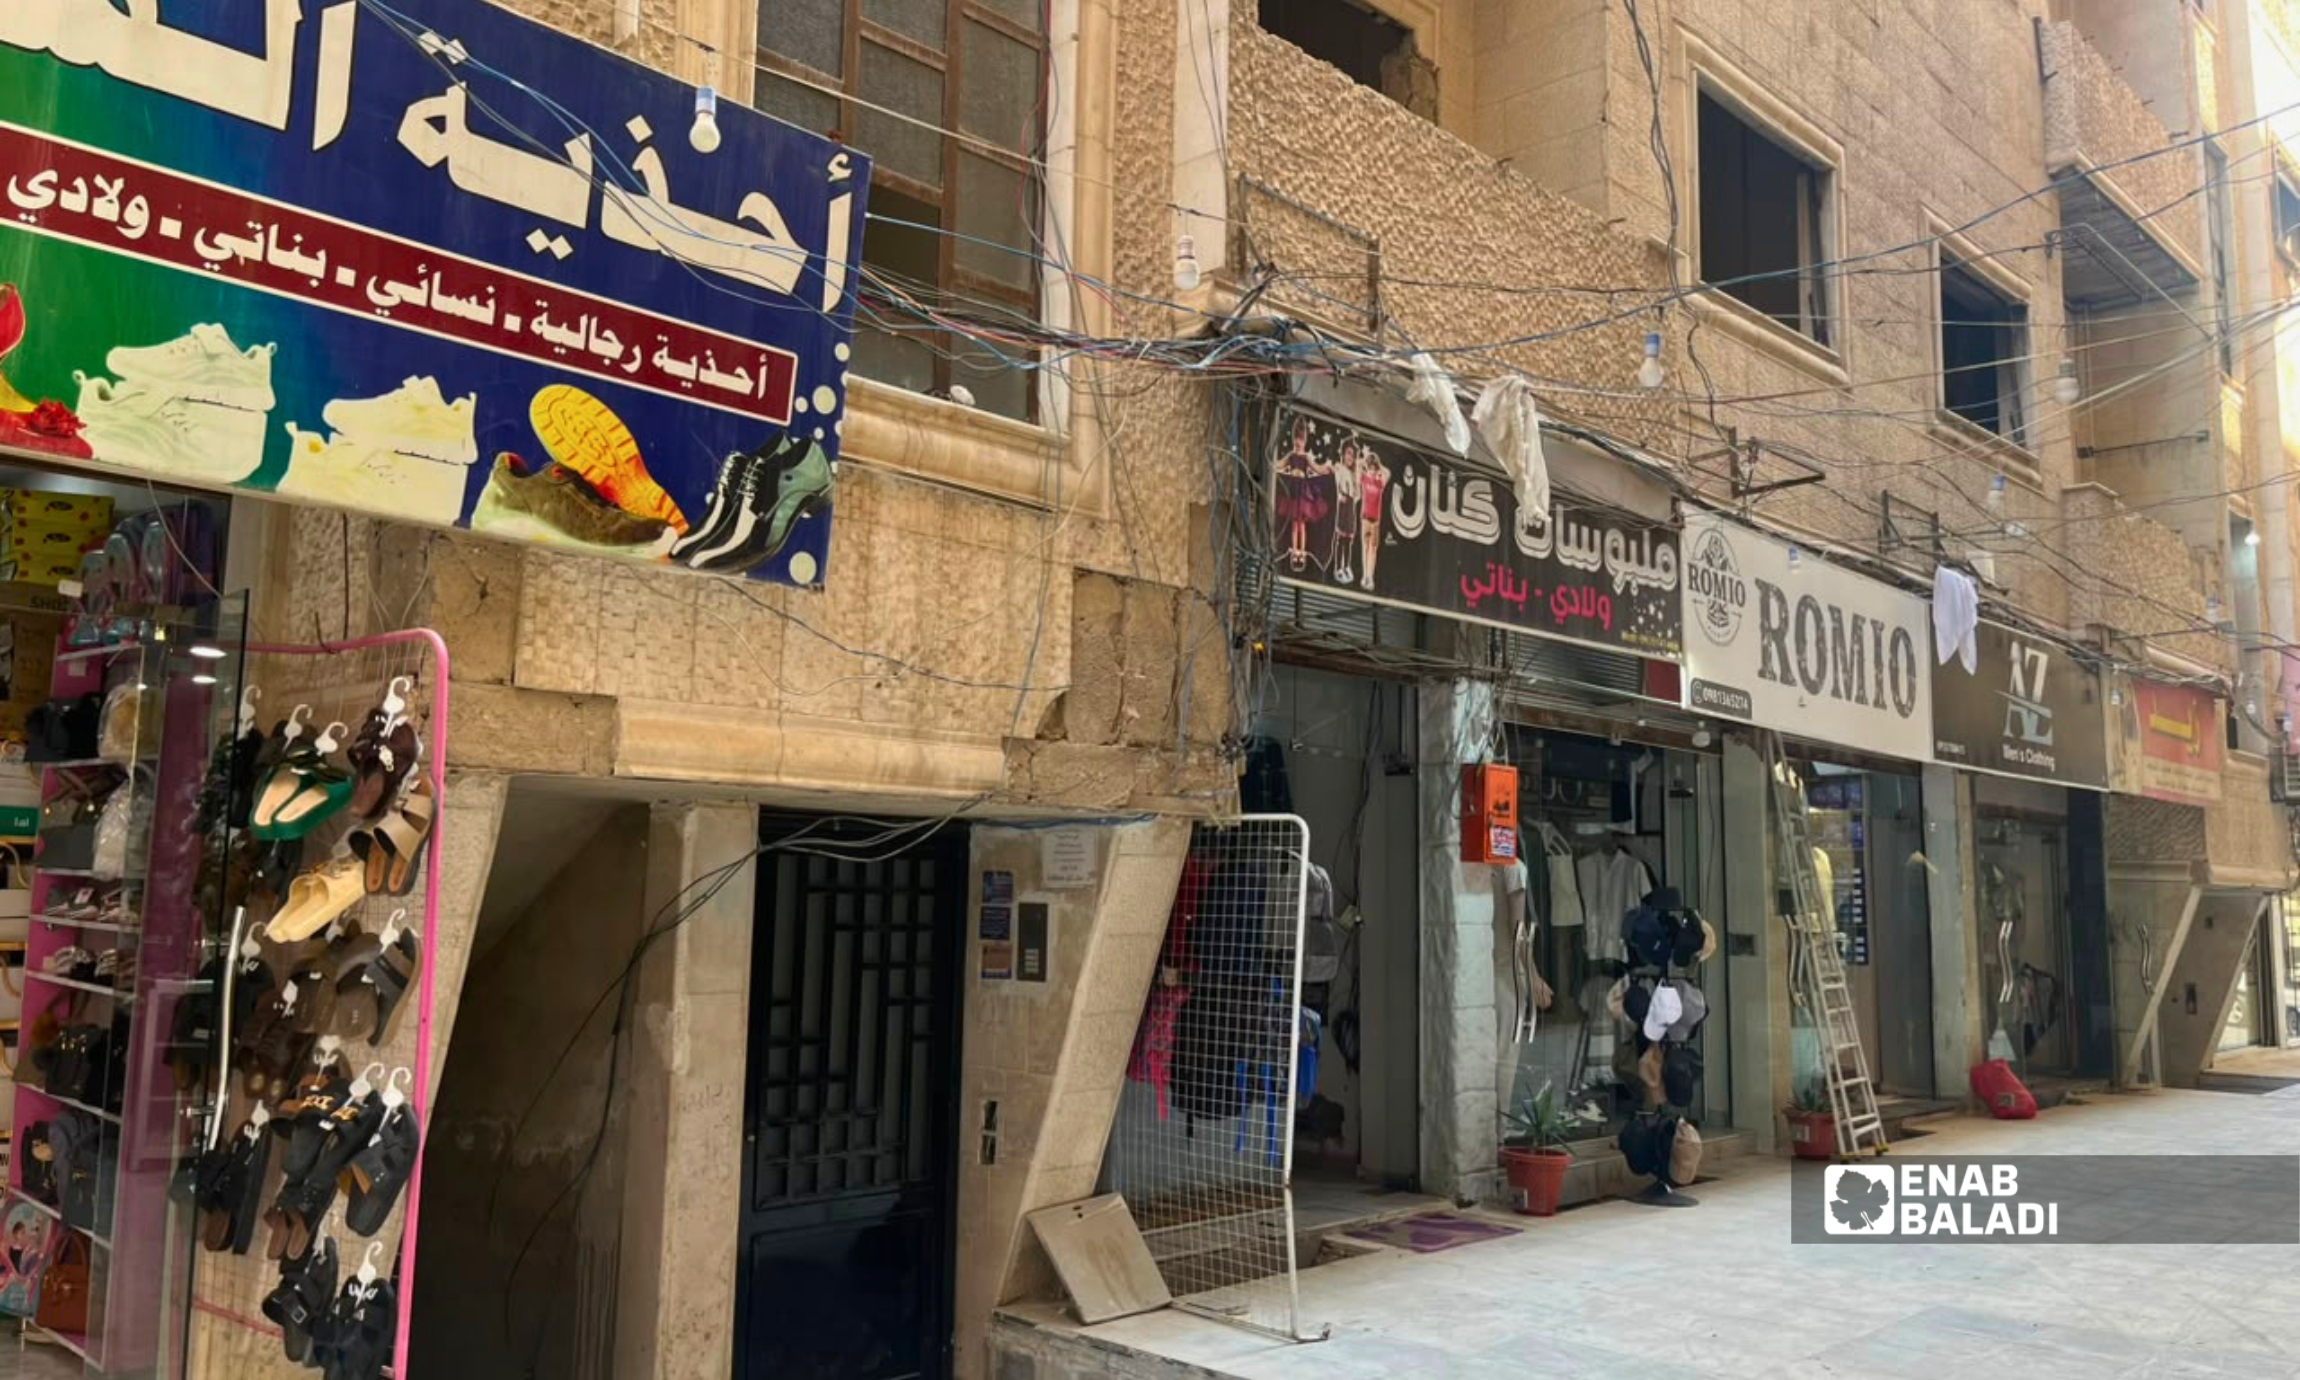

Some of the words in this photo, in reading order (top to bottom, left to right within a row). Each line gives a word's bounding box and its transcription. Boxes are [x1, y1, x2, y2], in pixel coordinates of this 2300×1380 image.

[7, 168, 151, 240] ولادي
[397, 30, 852, 314] أحذية
[194, 221, 327, 287] بناتي
[366, 262, 497, 326] نسائي
[529, 299, 642, 375] رجالية
[652, 334, 768, 399] أحذية
[1514, 503, 1678, 596] ملبوسات
[1460, 562, 1528, 613] بناتي
[1551, 583, 1612, 631] ولادي
[1687, 562, 1746, 608] ROMIO
[1754, 577, 1917, 719] ROMIO
[2026, 748, 2056, 773] Clothing
